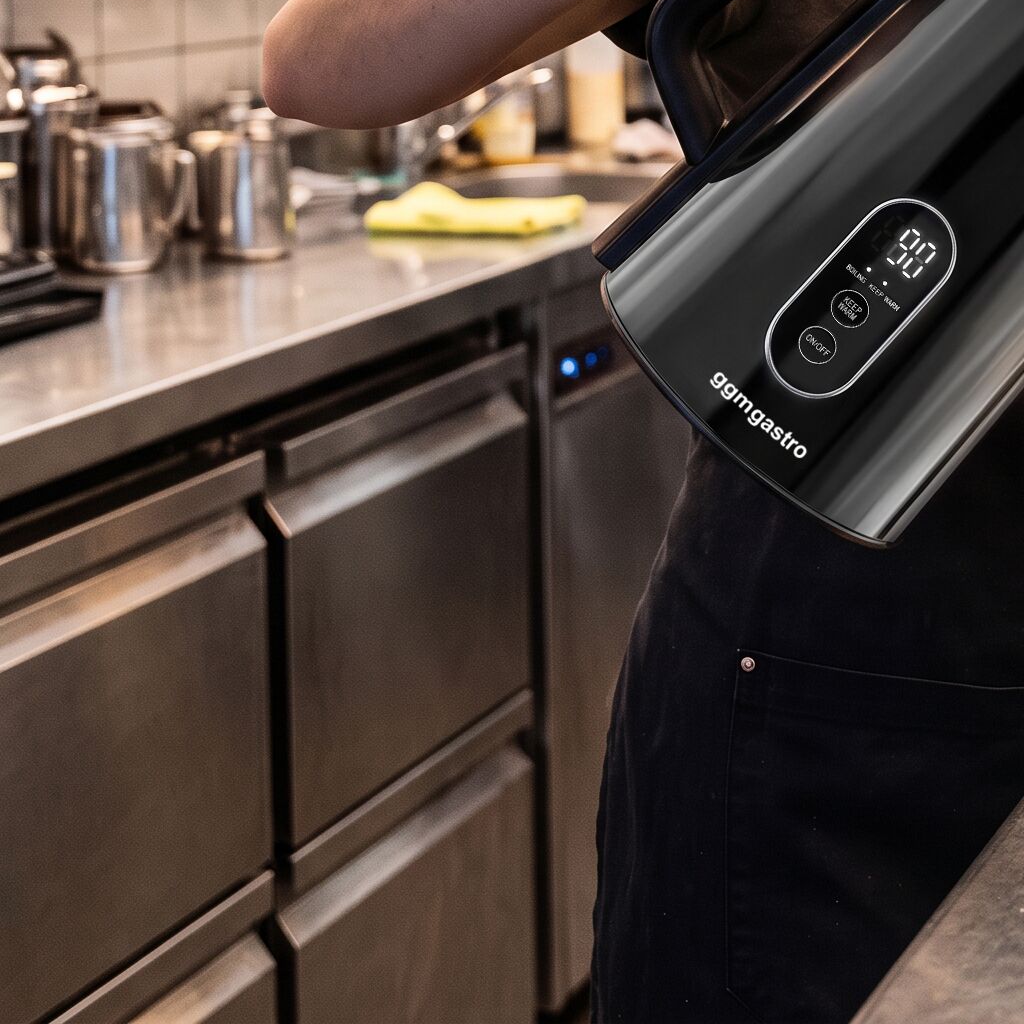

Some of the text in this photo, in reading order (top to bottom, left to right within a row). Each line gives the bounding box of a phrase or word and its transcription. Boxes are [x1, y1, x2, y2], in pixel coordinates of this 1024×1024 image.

[887, 228, 936, 278] 90
[846, 264, 867, 284] BOILING
[843, 296, 863, 313] KEEP
[868, 283, 901, 312] KEEP WARM
[837, 302, 858, 321] WARM
[805, 333, 831, 356] ON/OFF
[709, 371, 808, 459] ggmgastro
